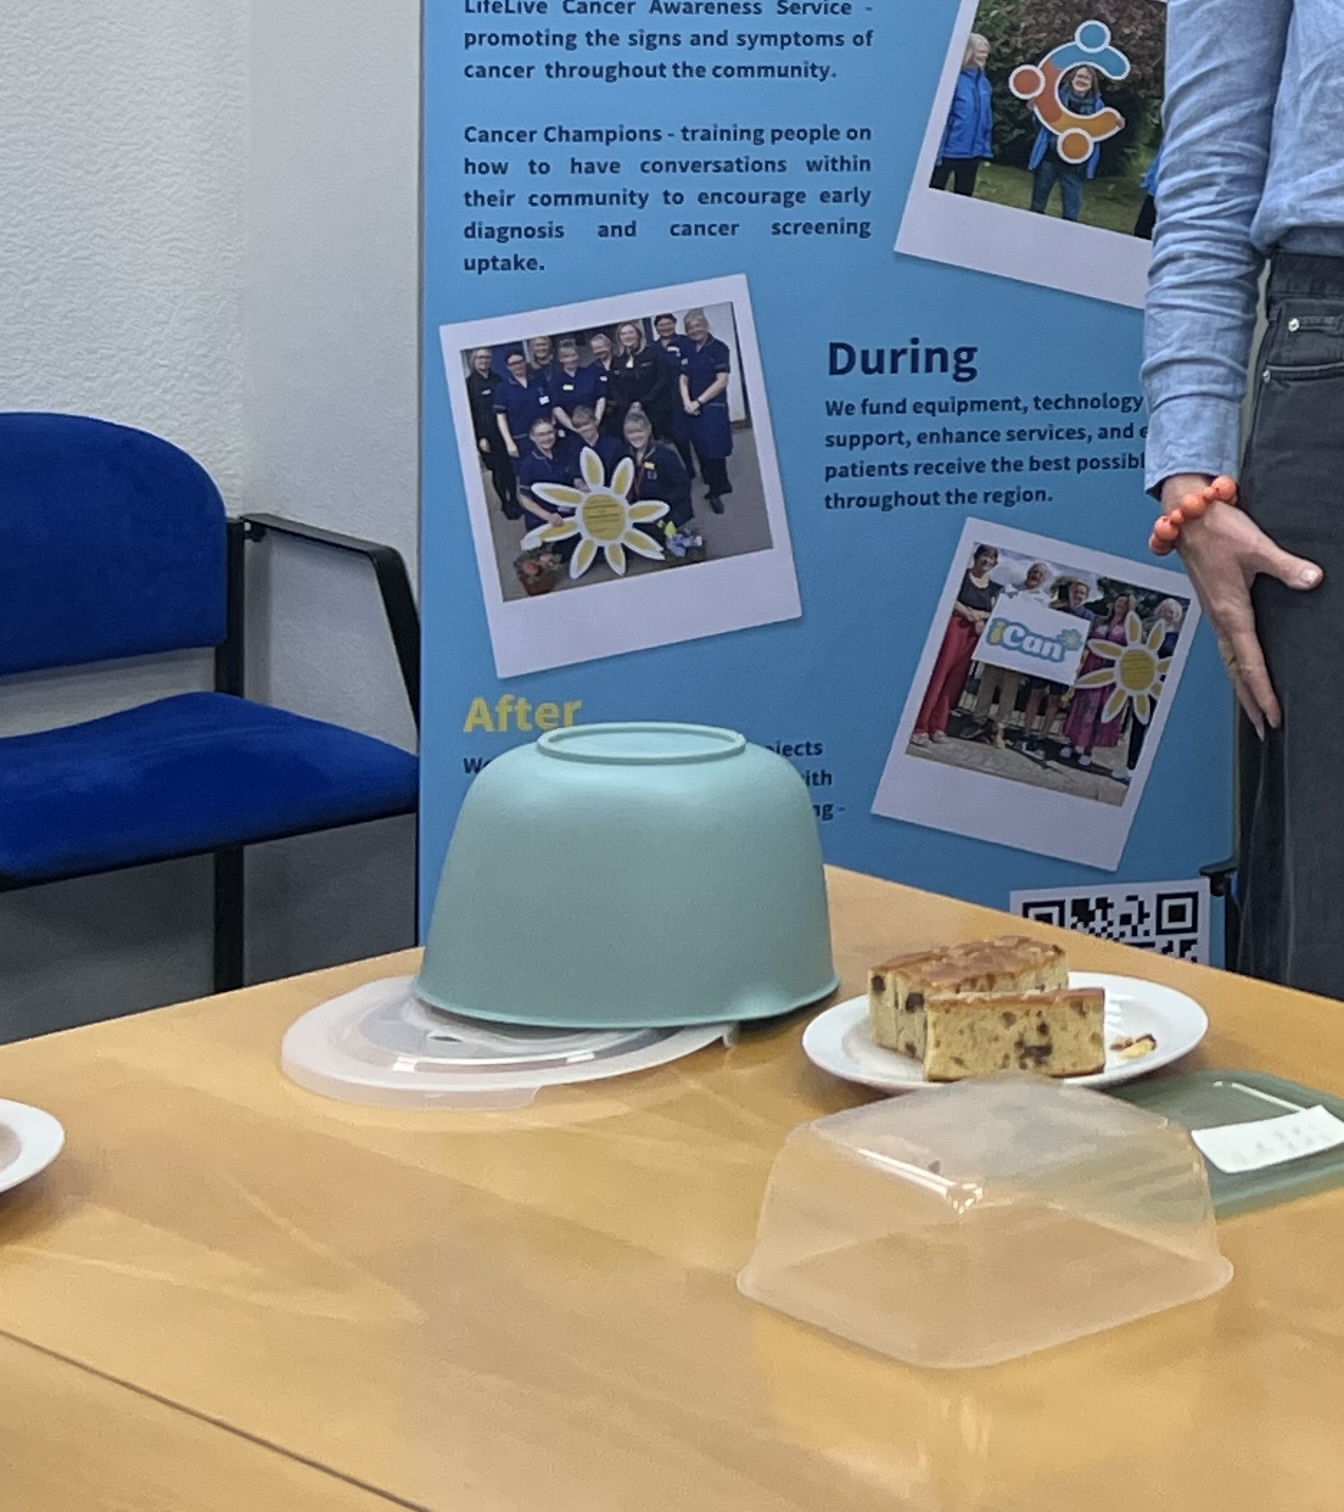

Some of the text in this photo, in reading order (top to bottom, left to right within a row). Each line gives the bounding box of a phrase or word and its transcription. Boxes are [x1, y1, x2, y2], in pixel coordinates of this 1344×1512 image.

[649, 0, 762, 14] Awareness
[777, 0, 851, 15] Service
[465, 29, 873, 50] promoting the signs and symptoms of
[464, 61, 836, 82] cancer throughout the community.
[465, 126, 537, 142] Cancer
[544, 125, 662, 146] Champions
[681, 124, 764, 145] training
[771, 124, 840, 145] people
[847, 128, 871, 140] on
[465, 155, 870, 174] how to have conversations within
[464, 187, 871, 209] their community to encourage early
[464, 217, 871, 243] diagnosis and cancer screening
[464, 254, 544, 275] uptake.
[829, 338, 977, 382] During
[826, 393, 1143, 417] We fund equipment, technology
[826, 431, 911, 451] support,
[917, 428, 1000, 444] enhance
[1007, 424, 1092, 443] services,
[1098, 422, 1133, 439] and
[825, 453, 1145, 482] patients receive the best possibl
[825, 486, 1052, 511] throughout the region.
[989, 621, 1063, 660] iCan
[464, 694, 582, 733] After
[766, 740, 823, 757] jects
[801, 769, 832, 786] ith
